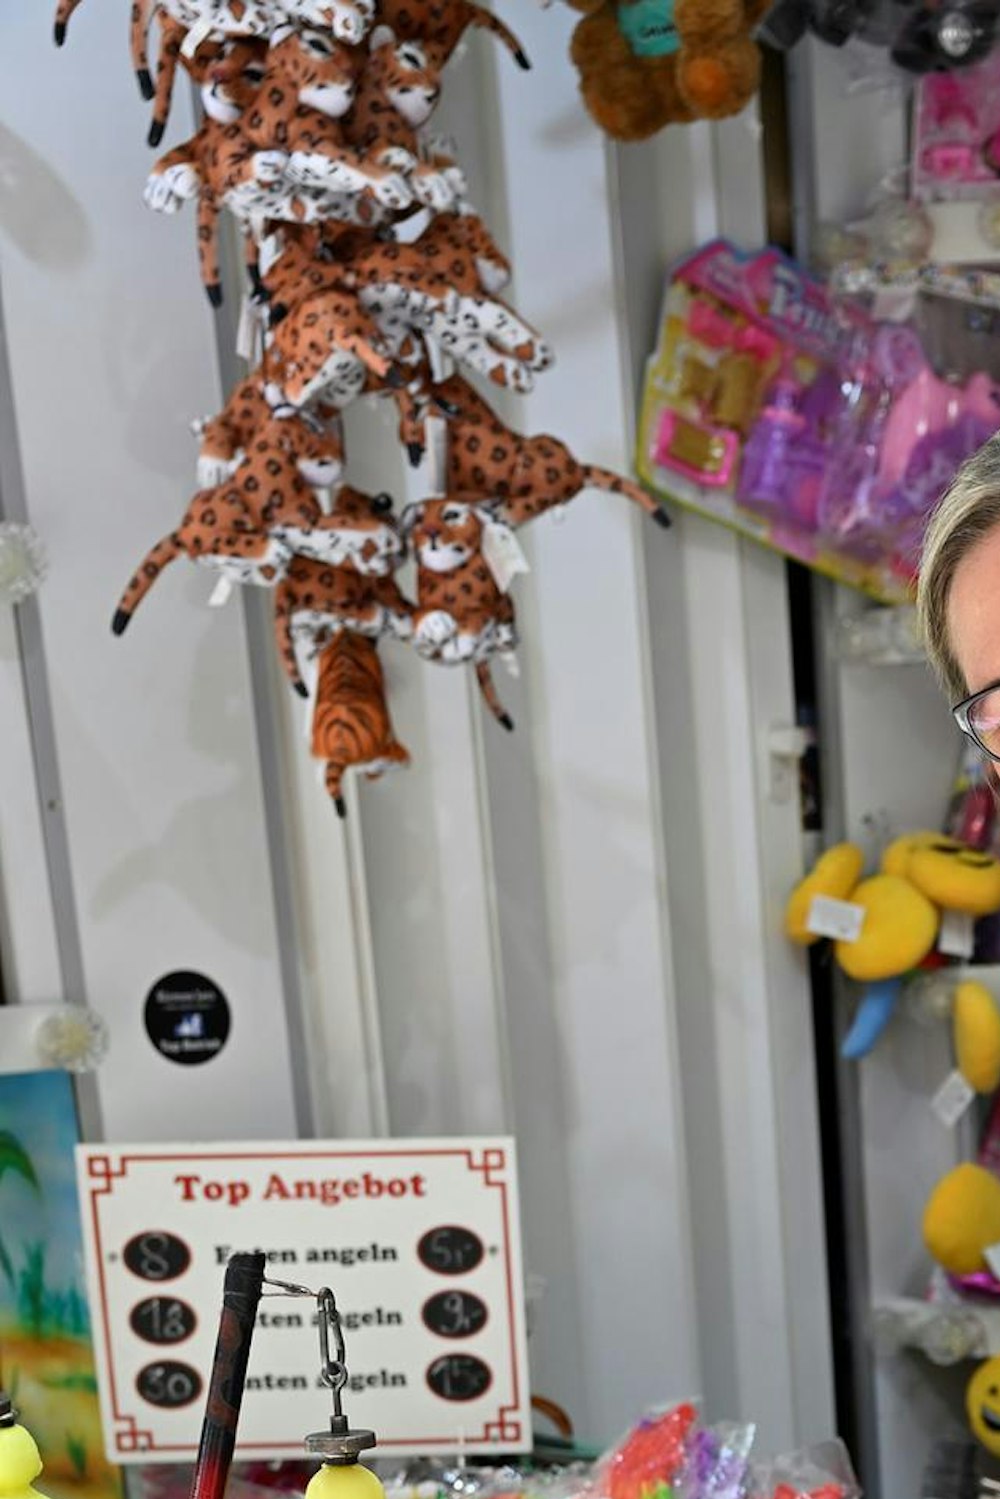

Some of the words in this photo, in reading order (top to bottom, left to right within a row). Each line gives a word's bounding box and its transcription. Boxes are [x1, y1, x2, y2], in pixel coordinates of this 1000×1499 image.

[175, 1174, 251, 1205] Top
[264, 1172, 426, 1206] Angebot
[213, 1243, 298, 1265] Een
[306, 1243, 398, 1267] angeln
[258, 1311, 303, 1328] ten
[311, 1307, 403, 1329] ageln
[245, 1374, 307, 1391] nten
[316, 1367, 407, 1391] ageln
